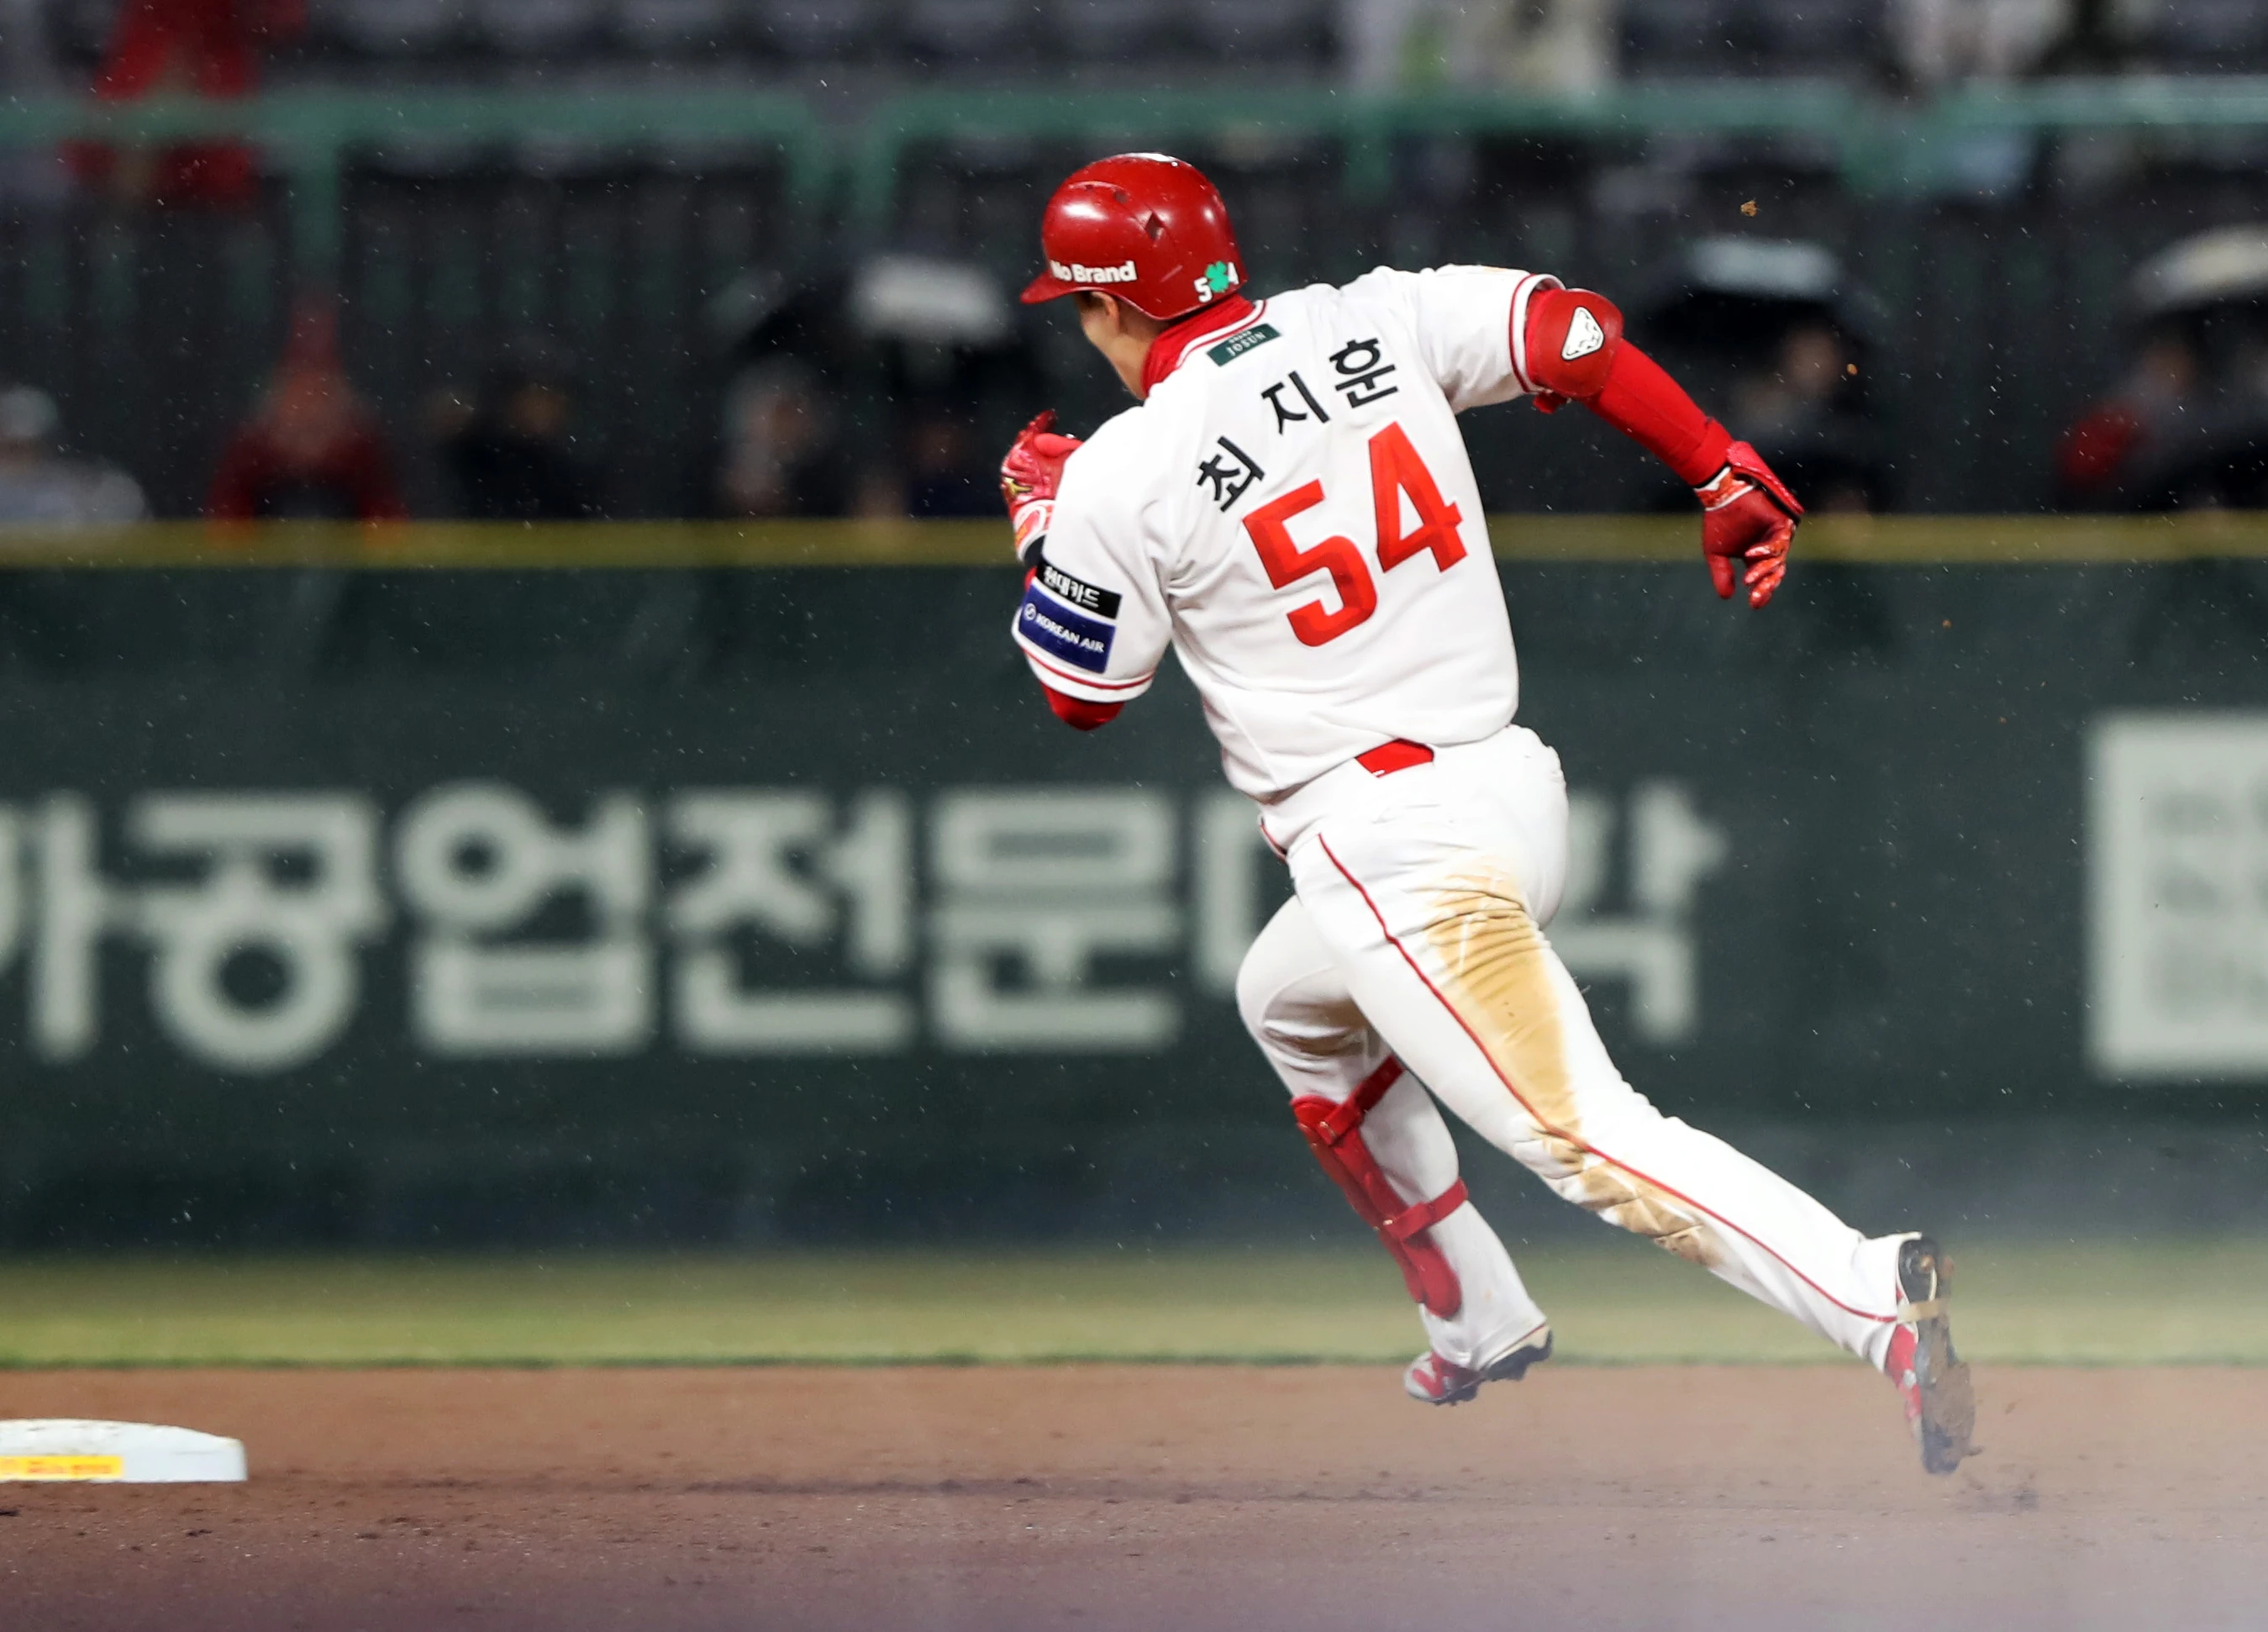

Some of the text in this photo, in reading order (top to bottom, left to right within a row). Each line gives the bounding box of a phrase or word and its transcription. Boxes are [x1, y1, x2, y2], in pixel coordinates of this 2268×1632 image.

[1050, 260, 1138, 283] No Brand
[1226, 331, 1266, 356] JOSUN
[1243, 422, 1467, 647] 54
[1043, 566, 1100, 608] 현대카드
[1034, 613, 1105, 654] KOREAN AIR
[0, 777, 1724, 1076] 공업전문
